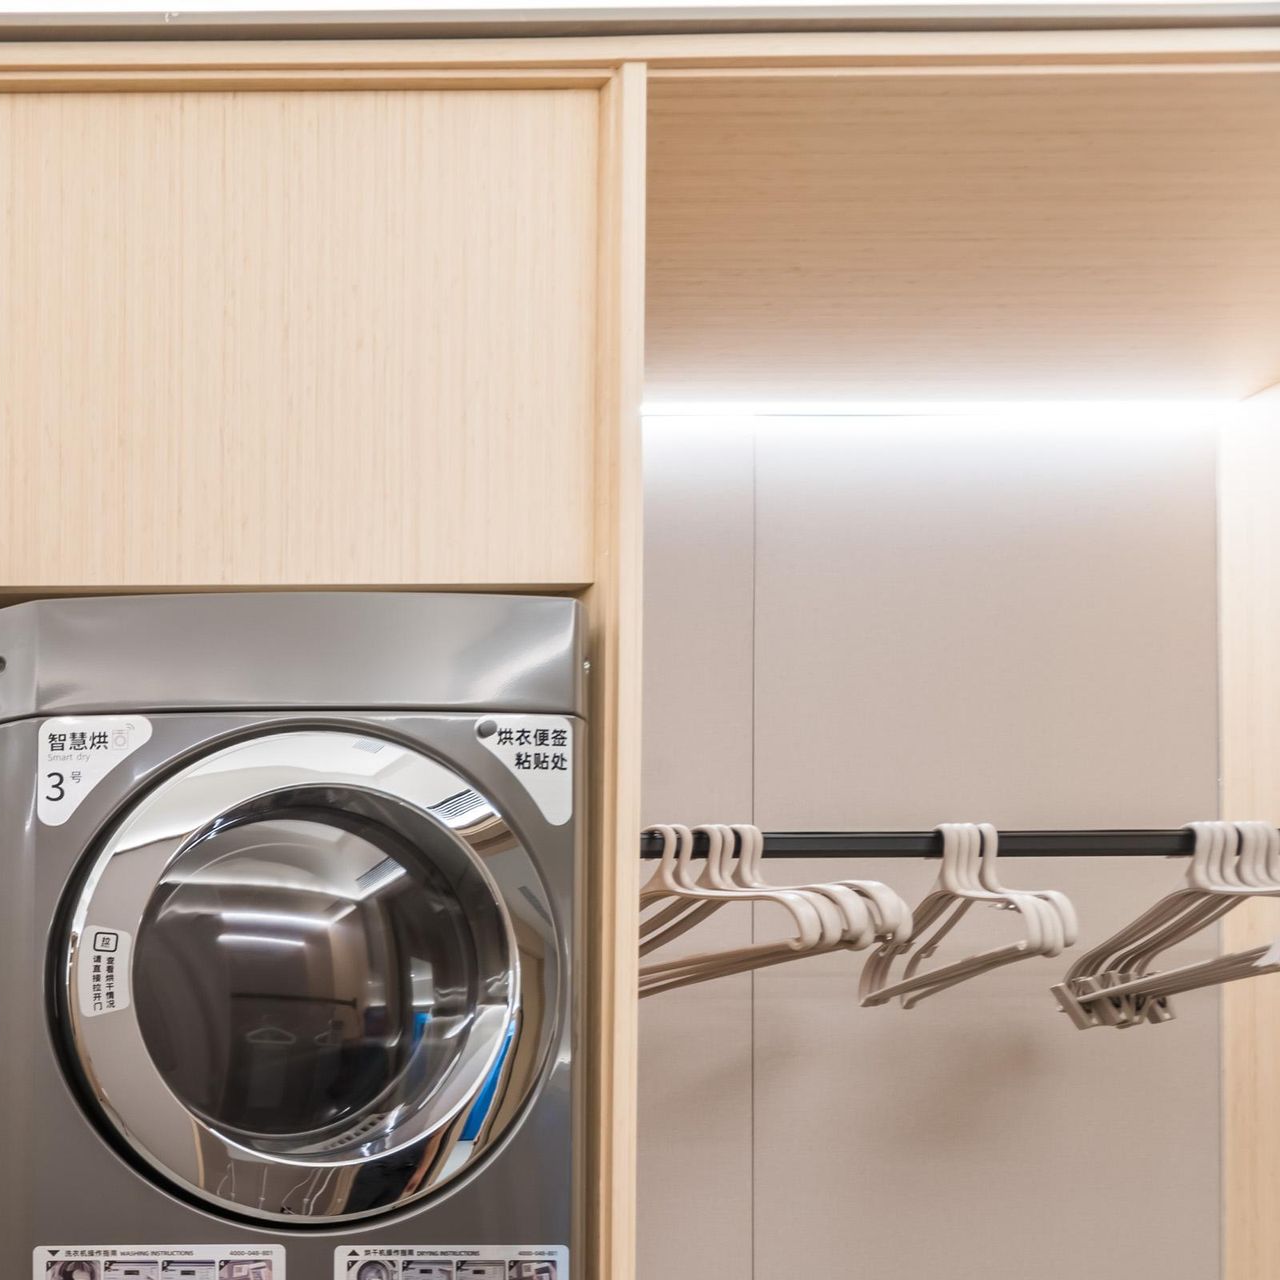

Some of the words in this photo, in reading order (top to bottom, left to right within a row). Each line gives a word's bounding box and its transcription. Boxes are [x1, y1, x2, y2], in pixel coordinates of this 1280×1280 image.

[48, 732, 109, 751] 智慧烘
[497, 728, 568, 747] 烘衣便签
[48, 753, 72, 762] Smart
[77, 753, 91, 763] dry
[514, 752, 568, 770] 粘贴处
